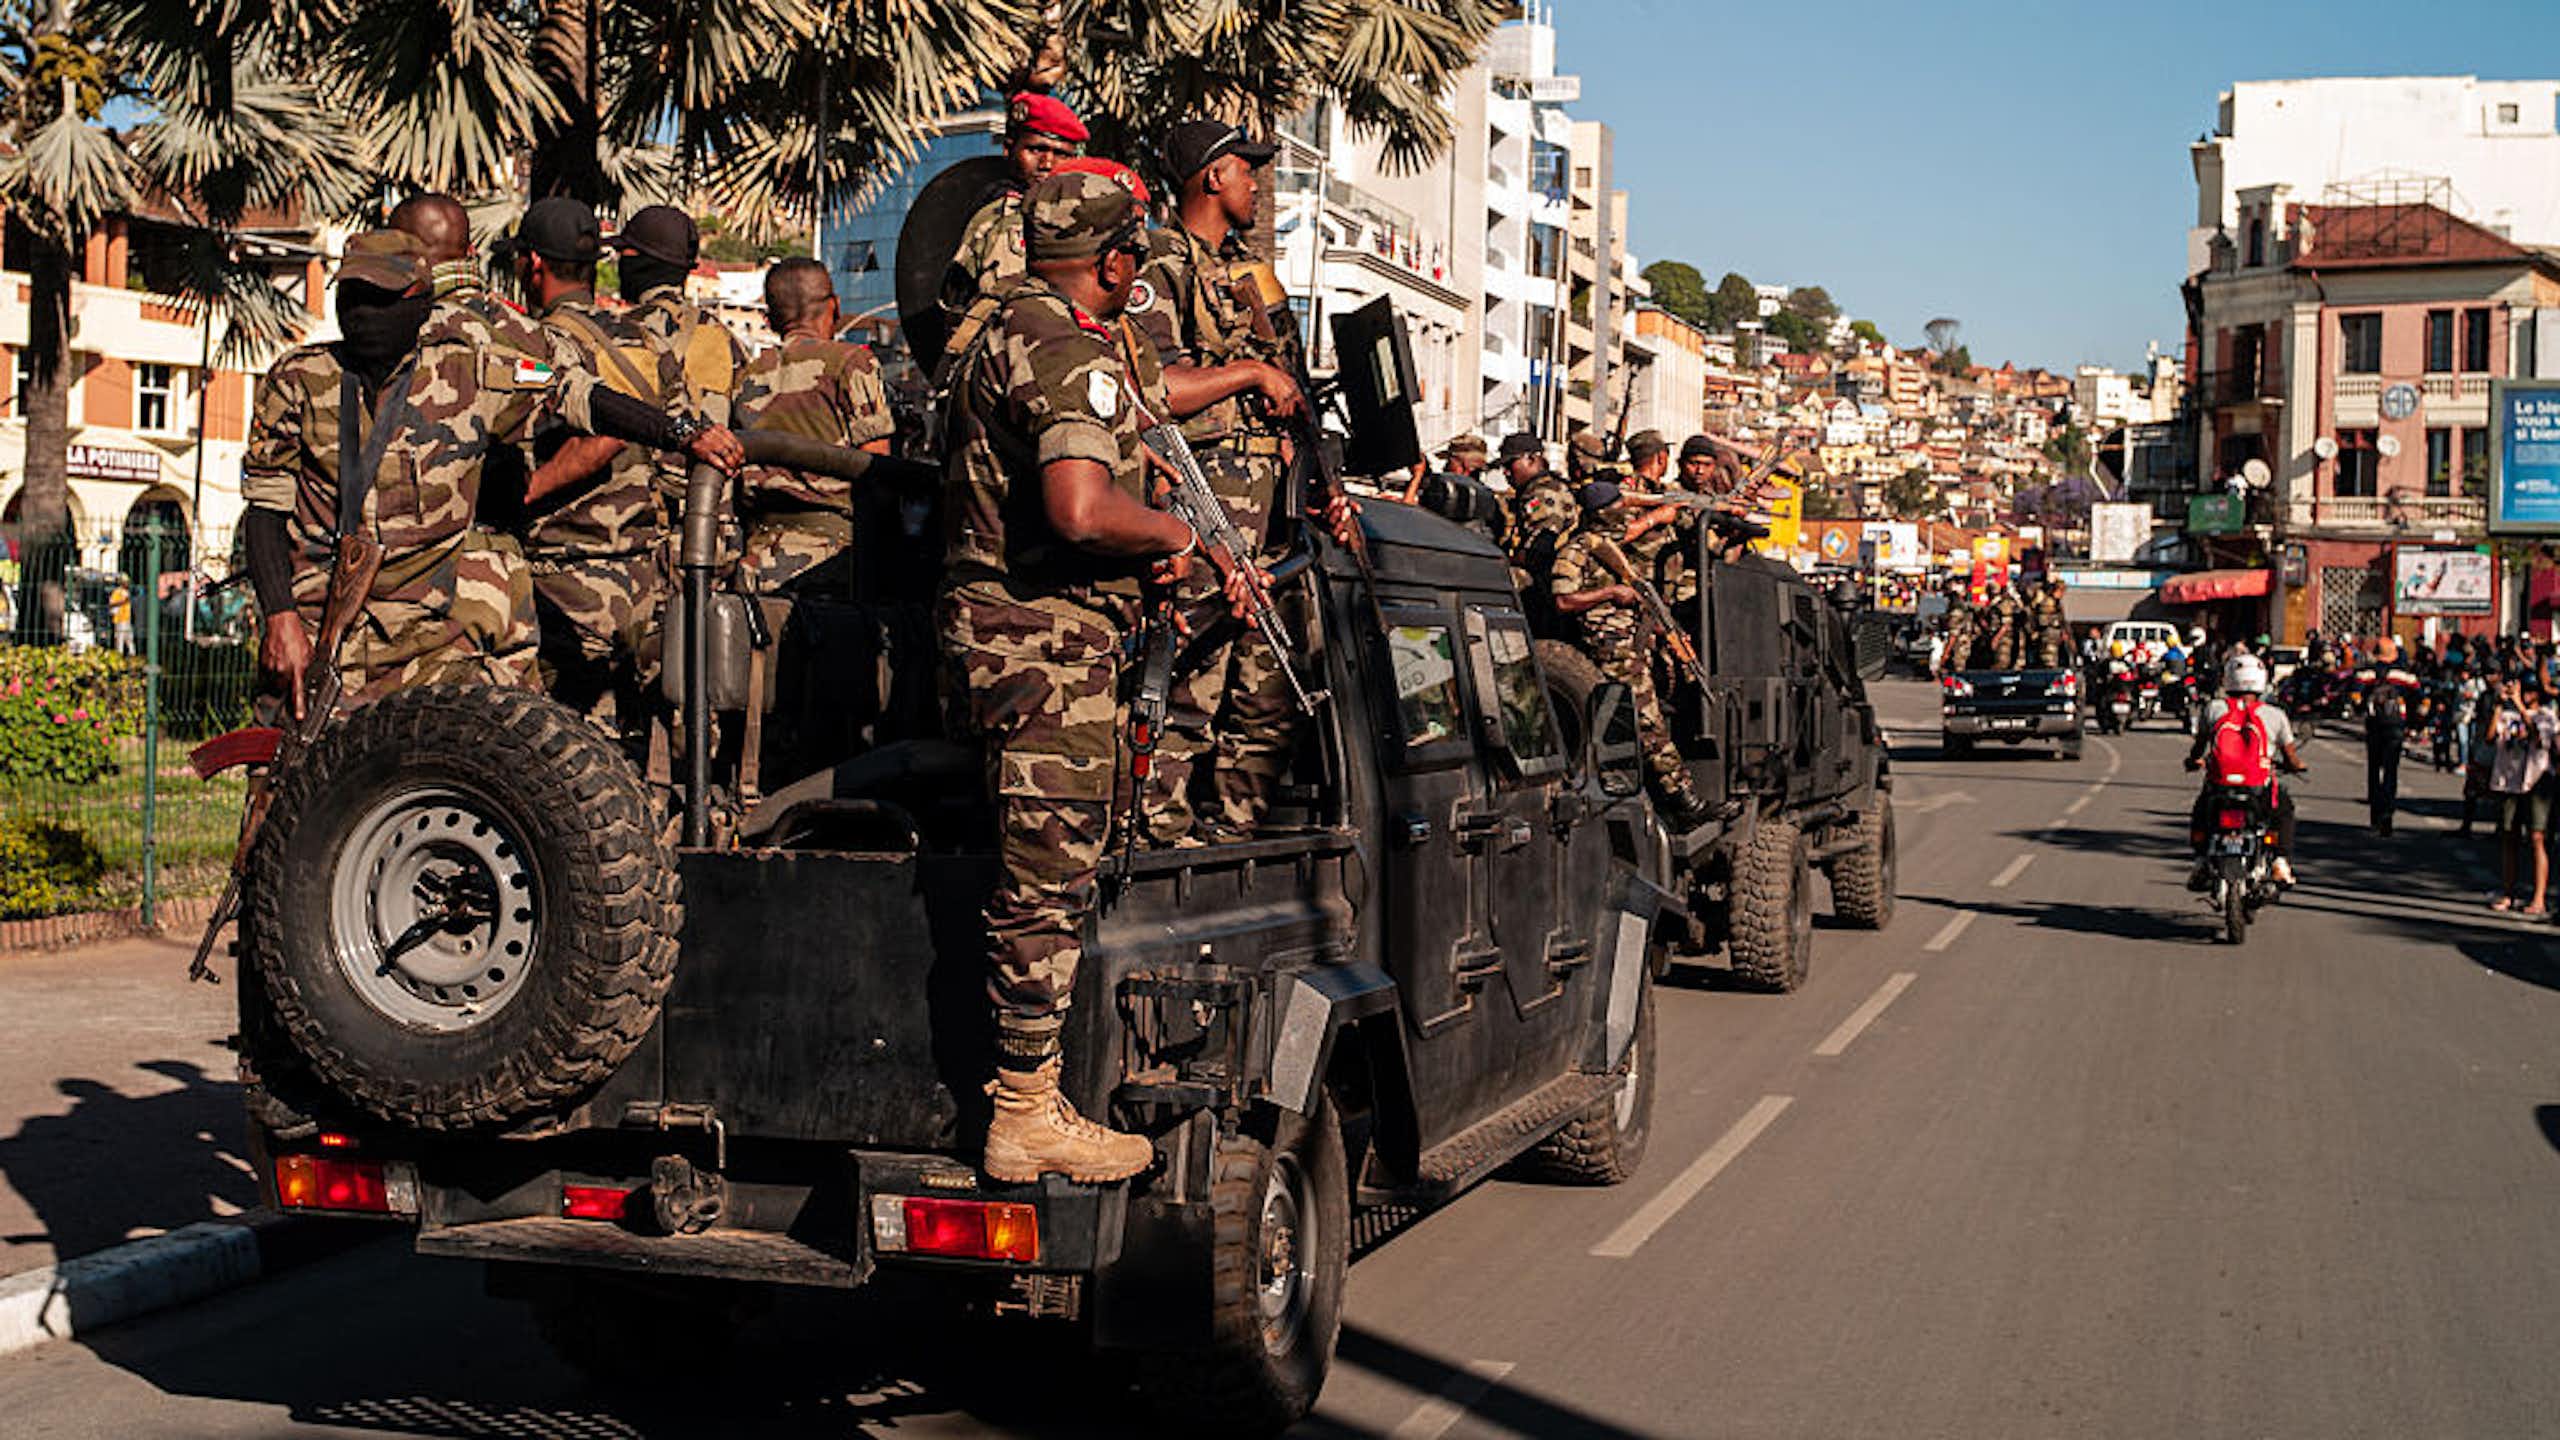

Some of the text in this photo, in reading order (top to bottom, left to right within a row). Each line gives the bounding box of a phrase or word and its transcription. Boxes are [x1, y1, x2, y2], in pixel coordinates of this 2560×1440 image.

[1535, 79, 1573, 91] HOTEL
[2514, 399, 2534, 414] Le
[66, 445, 86, 465] LA
